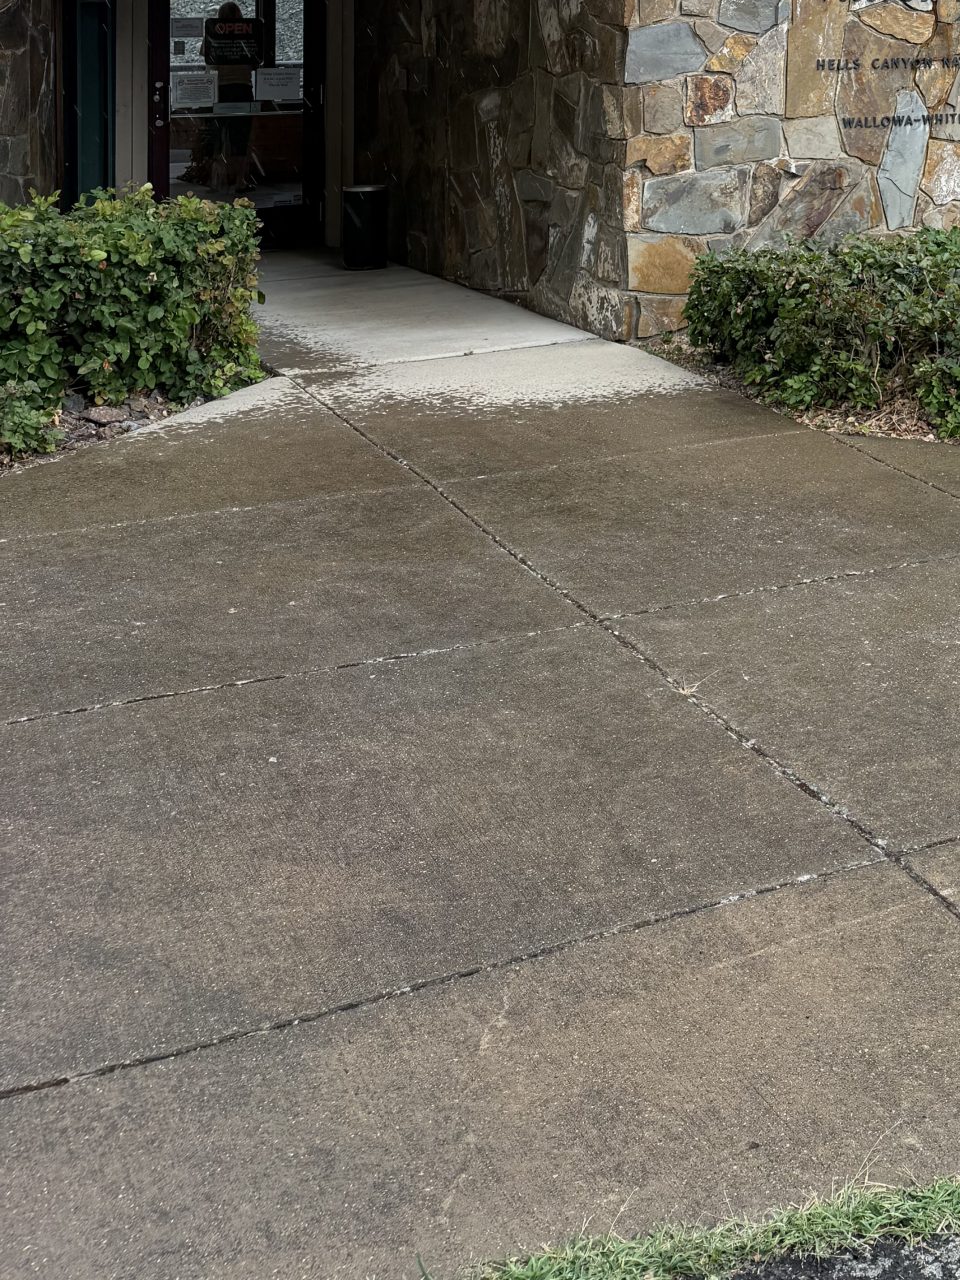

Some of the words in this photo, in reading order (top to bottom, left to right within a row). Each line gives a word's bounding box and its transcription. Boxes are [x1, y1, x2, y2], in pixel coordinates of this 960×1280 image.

[215, 22, 253, 34] OPEN
[816, 58, 861, 71] HELLS
[871, 57, 933, 71] CANYON
